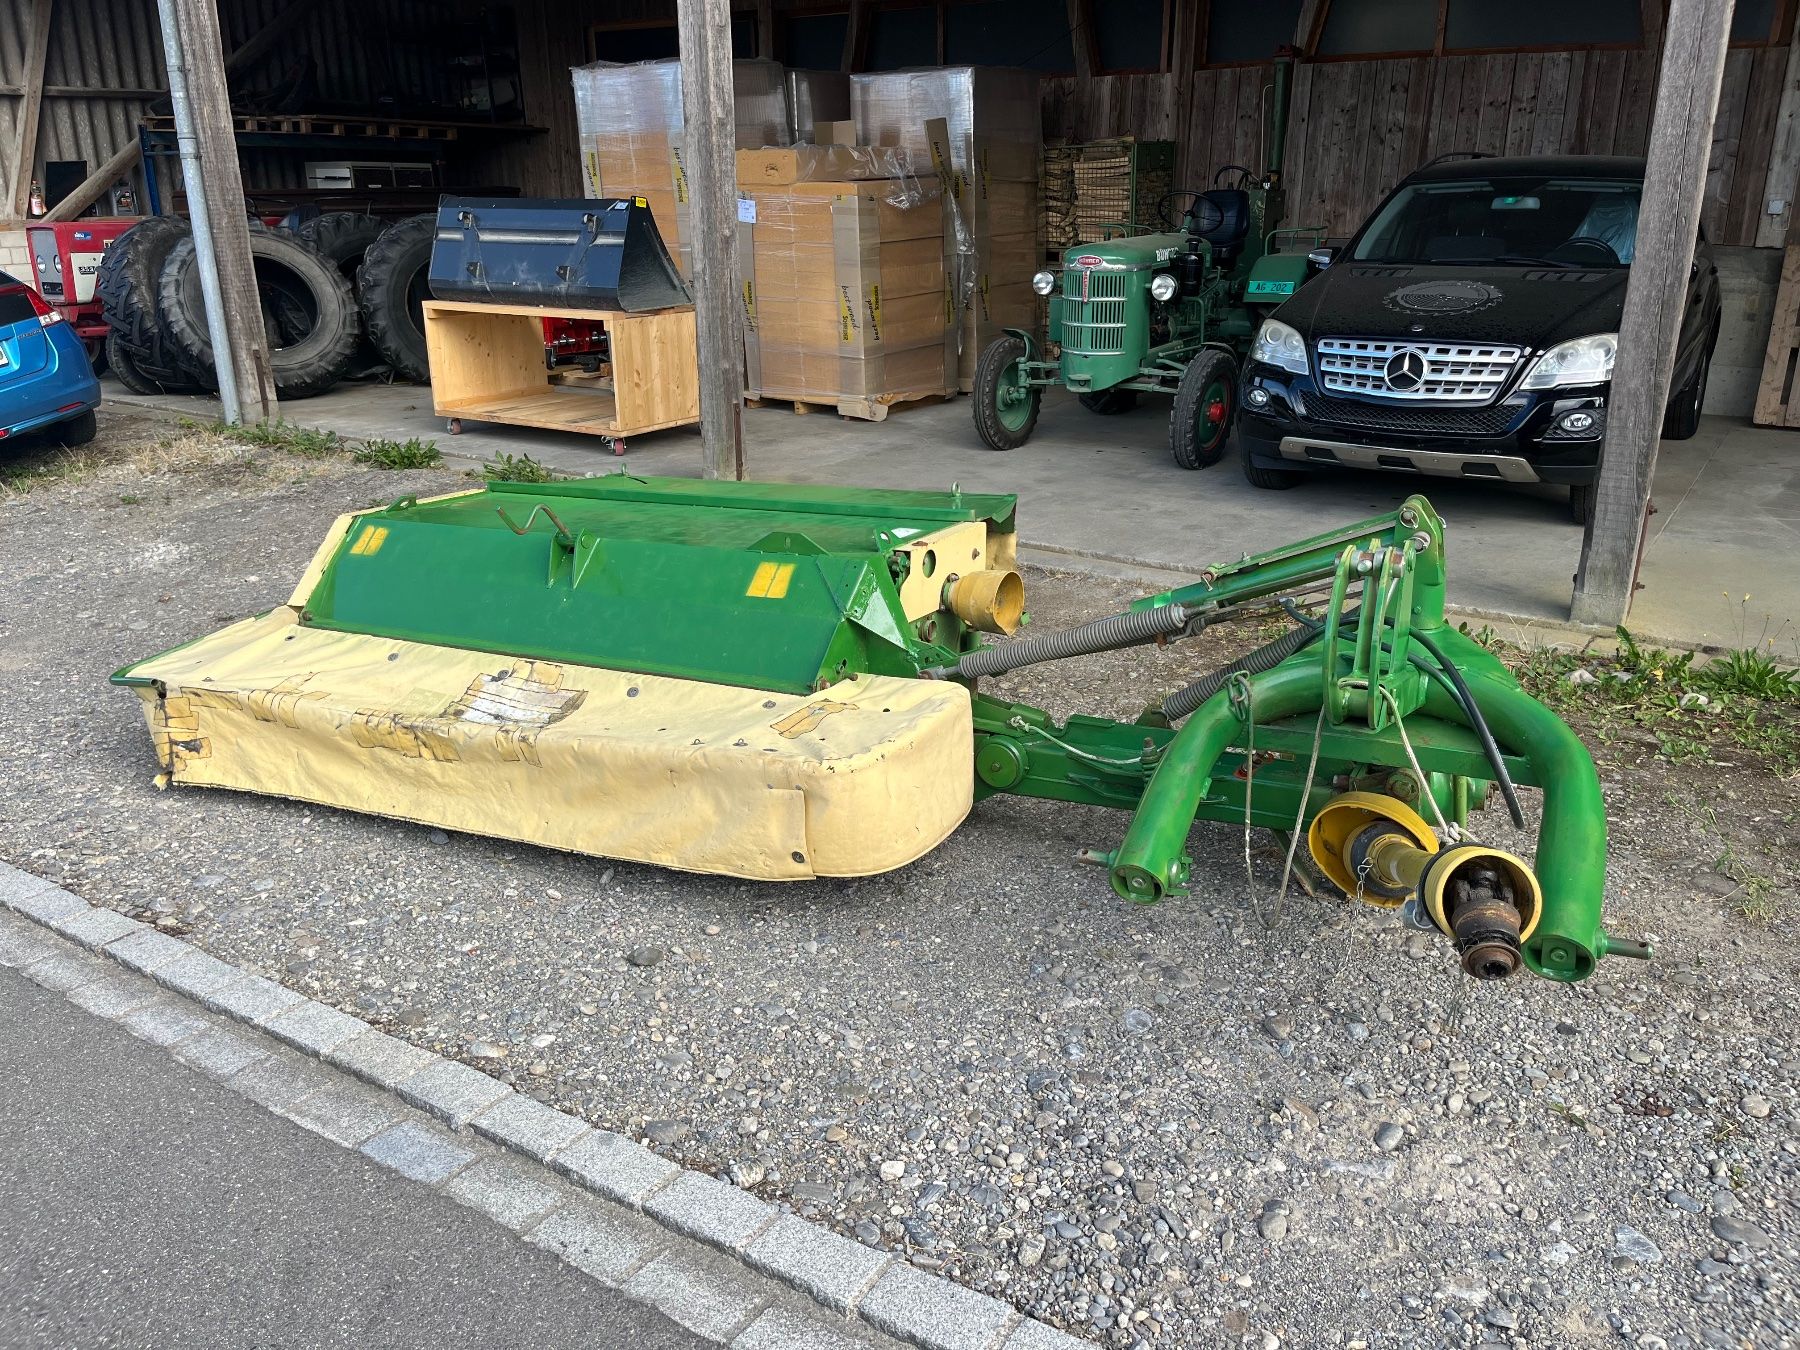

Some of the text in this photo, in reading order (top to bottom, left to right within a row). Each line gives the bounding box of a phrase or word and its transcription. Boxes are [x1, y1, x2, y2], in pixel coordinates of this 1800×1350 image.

[673, 147, 683, 164] best
[841, 285, 861, 330] best wood
[864, 298, 880, 341] best wood
